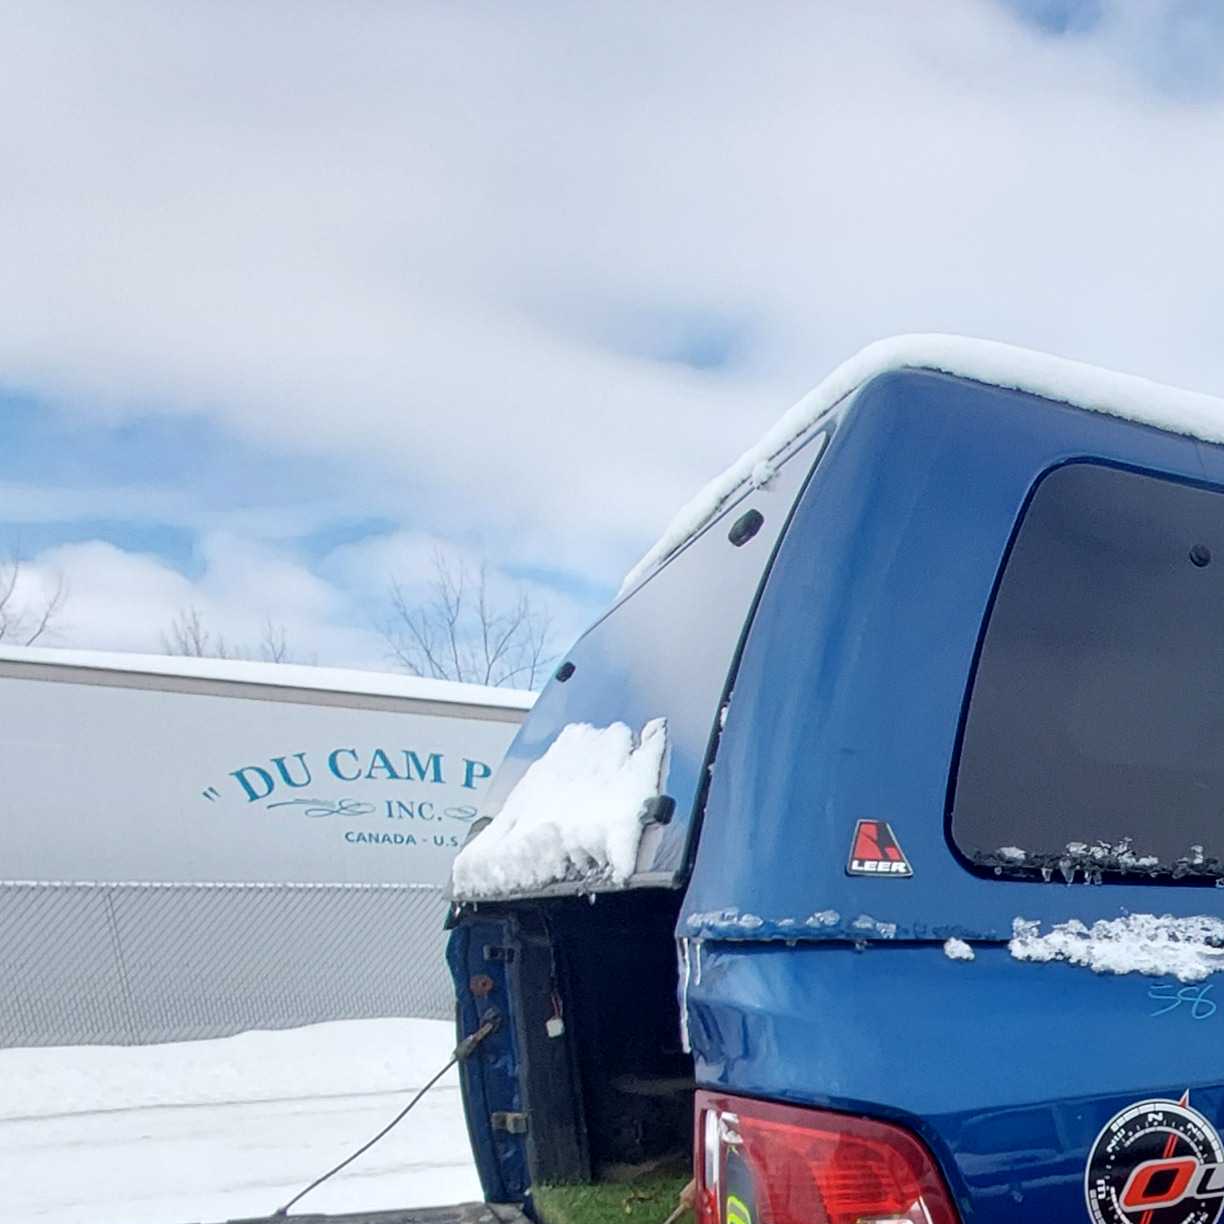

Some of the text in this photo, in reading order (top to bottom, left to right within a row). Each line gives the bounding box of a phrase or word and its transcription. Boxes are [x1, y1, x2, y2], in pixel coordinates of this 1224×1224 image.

[385, 800, 444, 822] INC.
[344, 831, 418, 846] CANADA
[851, 860, 907, 873] LEER
